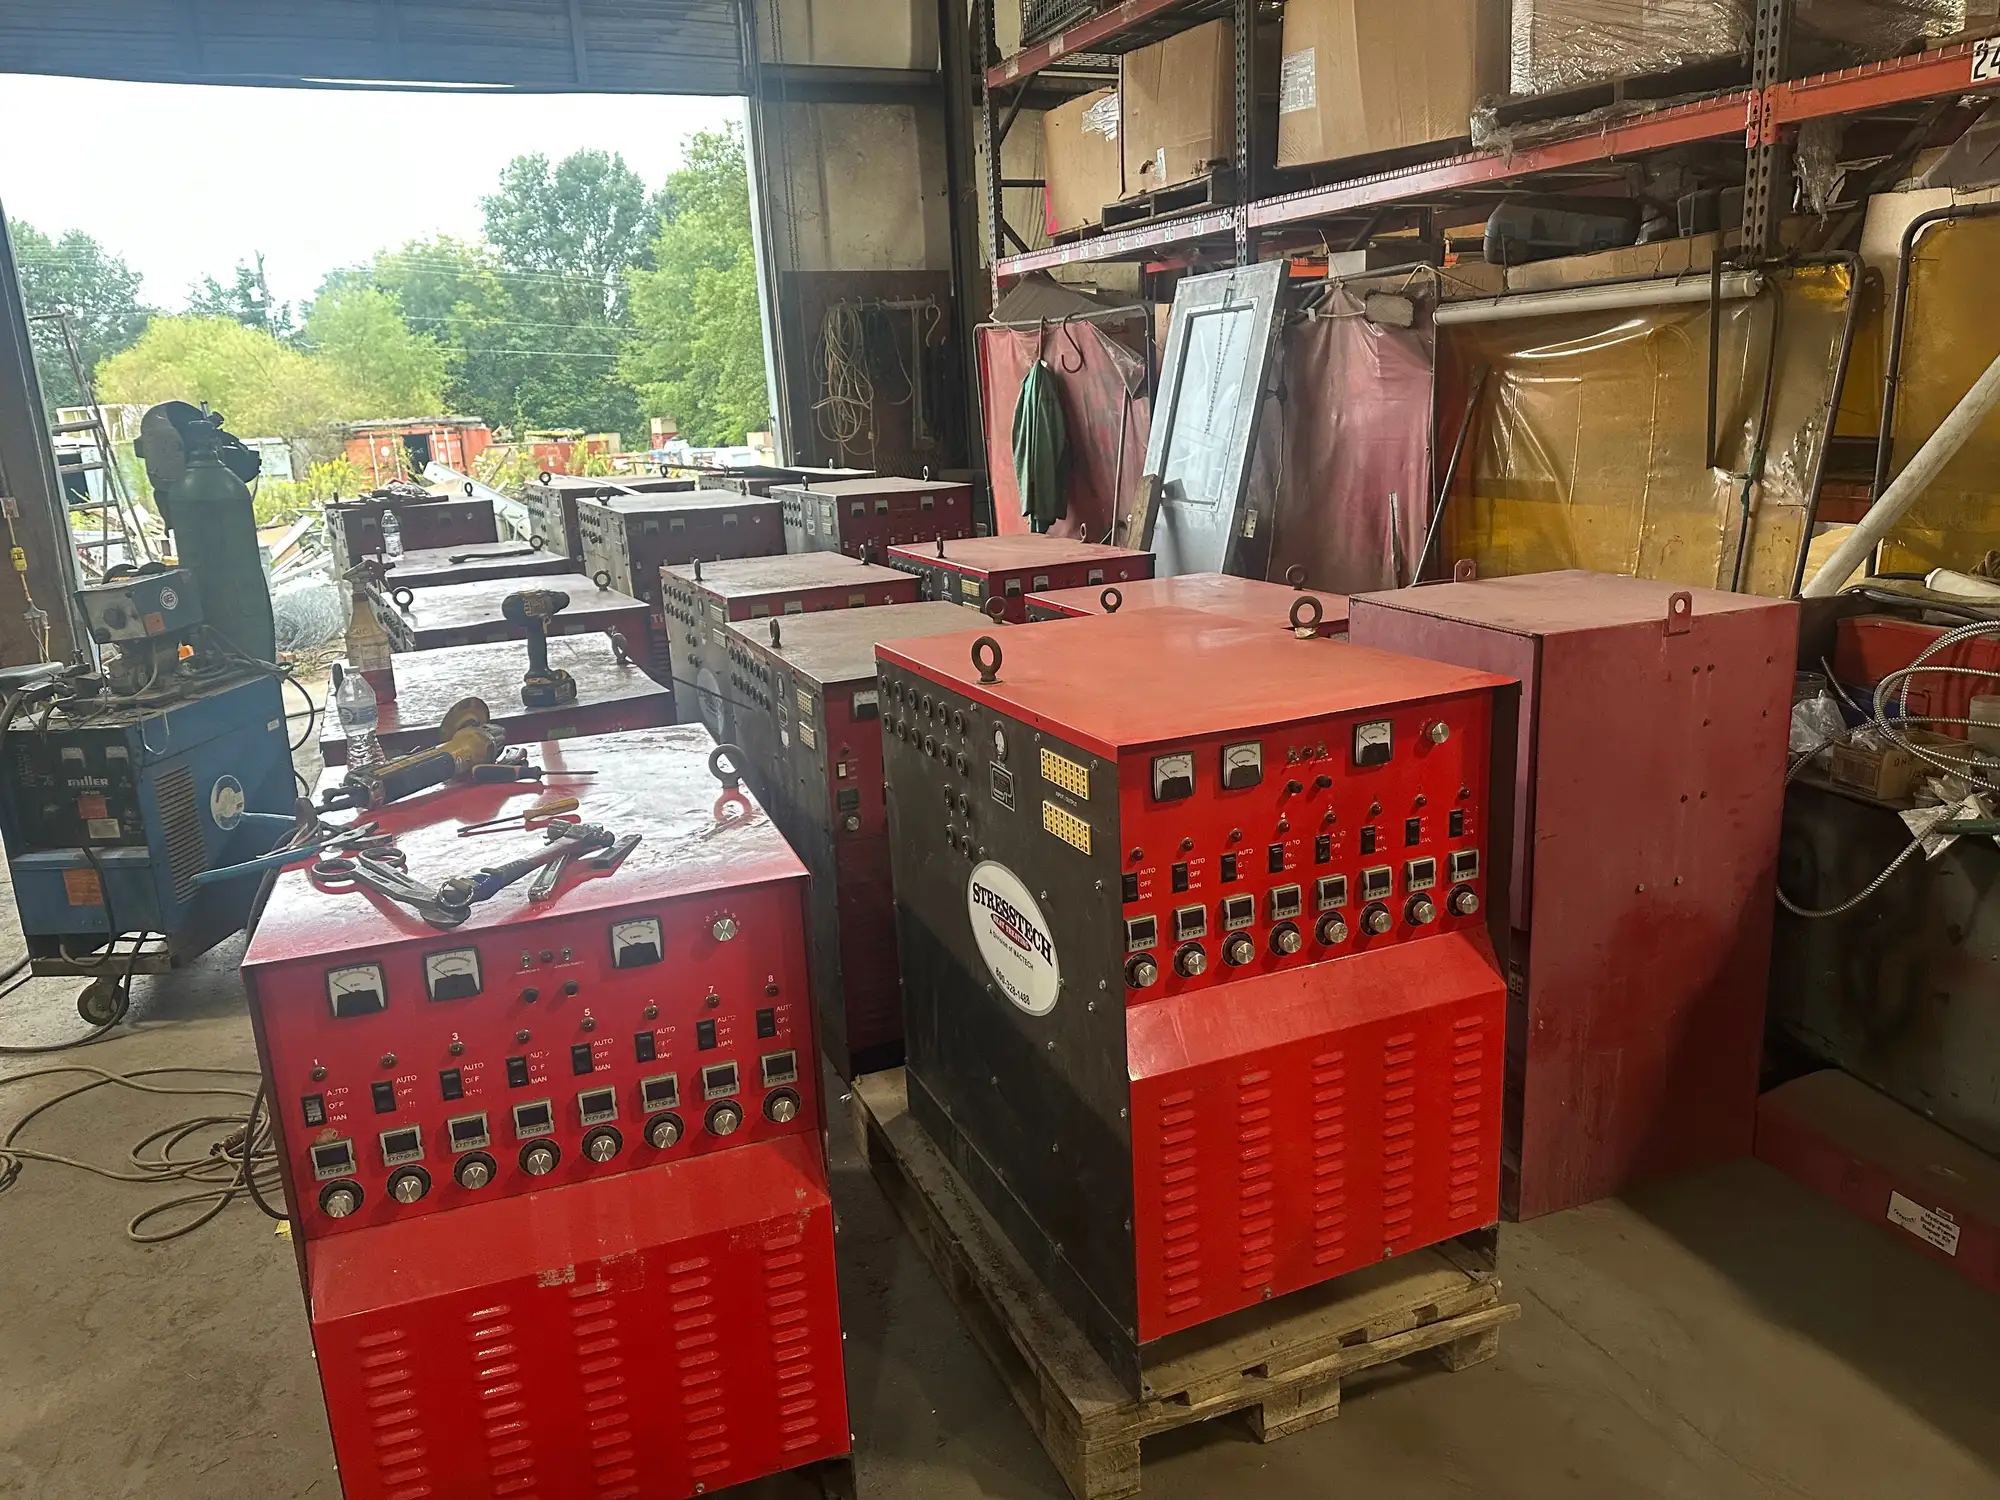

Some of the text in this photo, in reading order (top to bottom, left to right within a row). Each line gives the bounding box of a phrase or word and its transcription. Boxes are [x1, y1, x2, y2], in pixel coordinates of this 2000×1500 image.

[1189, 857, 1205, 865] AUTO
[1140, 867, 1156, 875] AUTO
[1189, 870, 1201, 878] OFF
[972, 882, 1053, 967] STRESSTECH
[768, 974, 774, 982] 8
[708, 985, 714, 993] 7
[584, 1007, 591, 1016] 5
[656, 1025, 676, 1035] AUTO
[451, 1032, 459, 1041] 3
[593, 1038, 614, 1047] AUTO
[594, 1051, 609, 1059] OFF
[463, 1062, 484, 1071] AUTO
[594, 1063, 611, 1072] MAN
[396, 1074, 418, 1083] AUTO
[530, 1075, 548, 1084] MAN
[327, 1087, 349, 1096] AUTO
